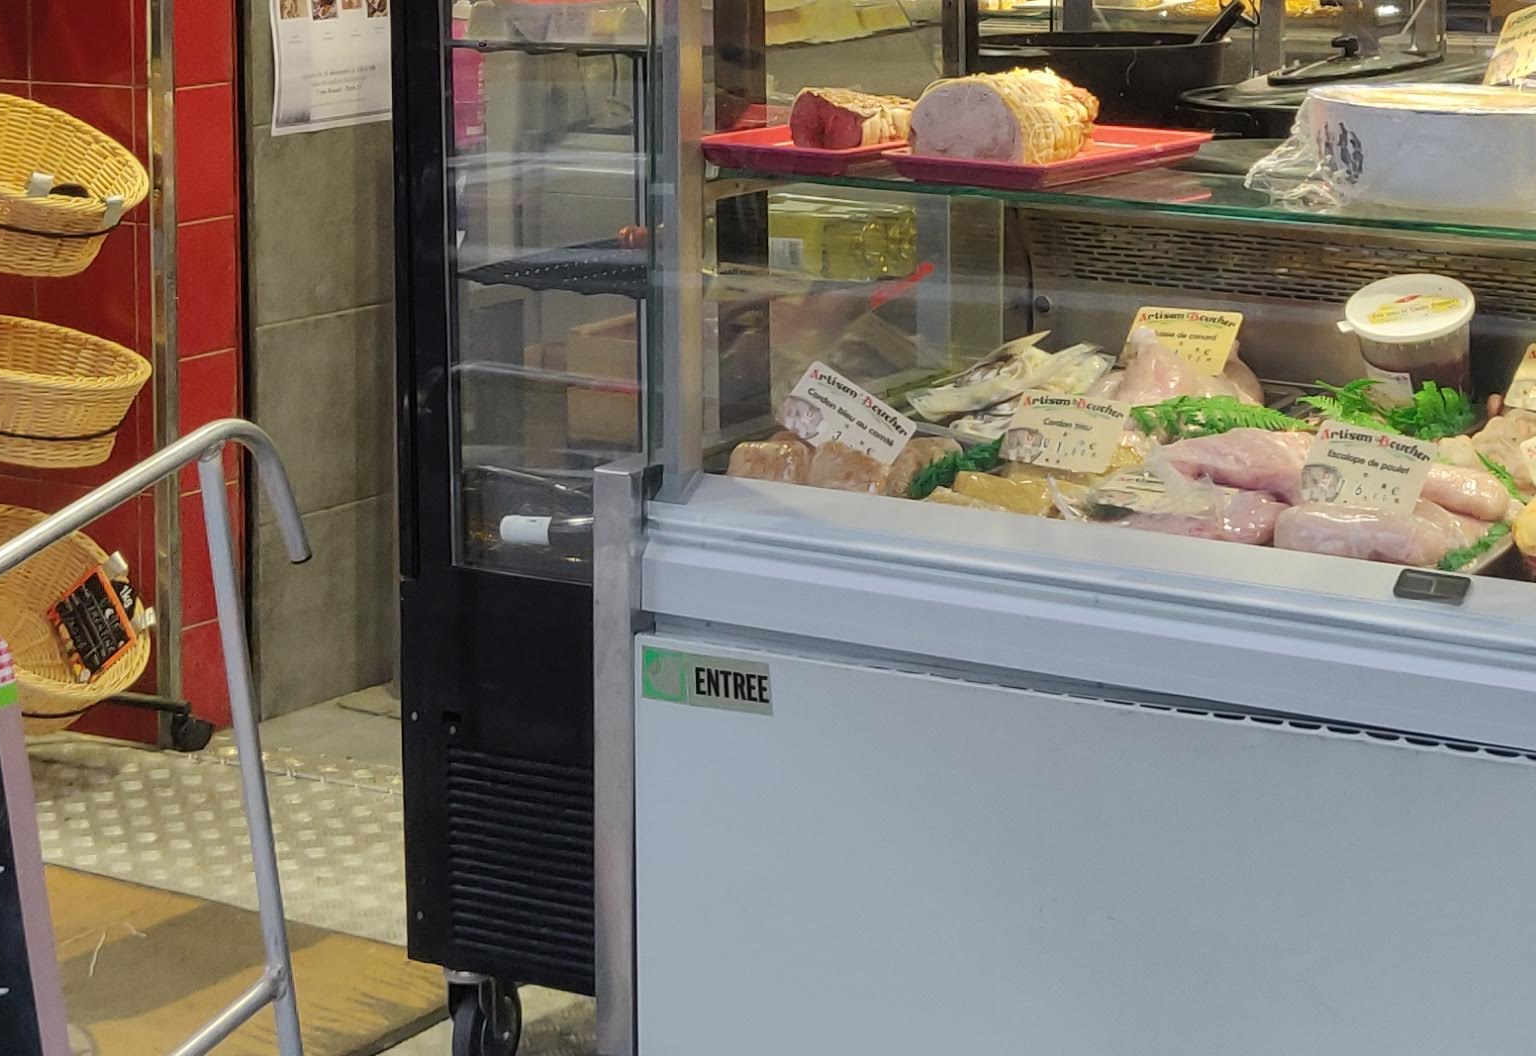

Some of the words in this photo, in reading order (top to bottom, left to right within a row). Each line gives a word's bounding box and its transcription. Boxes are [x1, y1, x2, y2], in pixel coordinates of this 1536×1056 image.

[1138, 310, 1184, 323] Artisan
[809, 369, 858, 399] Artisan
[1023, 395, 1071, 407] Artisan
[1321, 428, 1373, 443] Artisan
[694, 666, 770, 704] ENTREE
